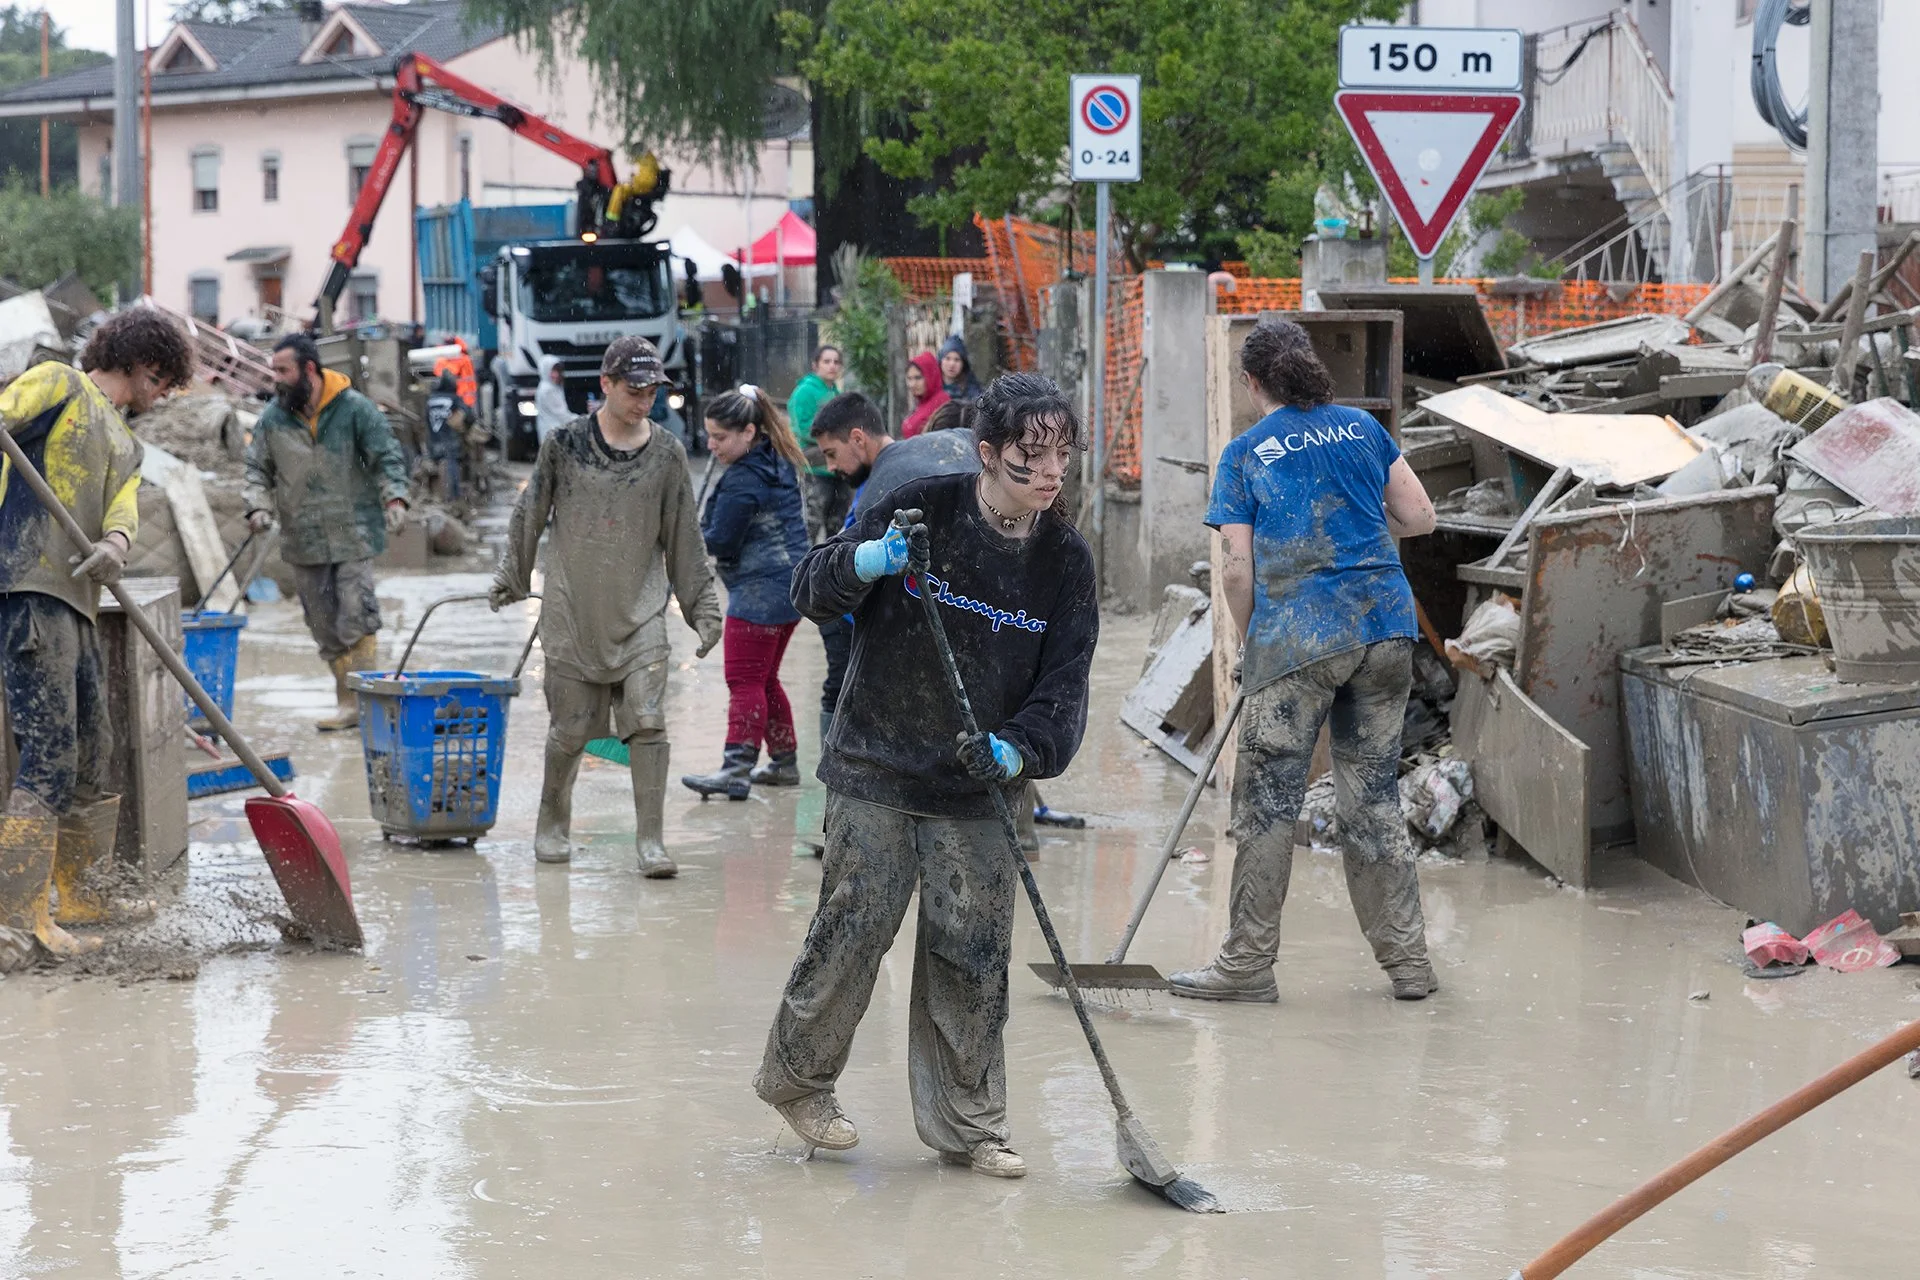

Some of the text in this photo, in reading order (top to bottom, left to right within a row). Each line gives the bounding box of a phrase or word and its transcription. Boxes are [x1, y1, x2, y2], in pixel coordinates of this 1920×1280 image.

[1369, 42, 1492, 73] 150 m
[1284, 422, 1365, 451] CAMAC
